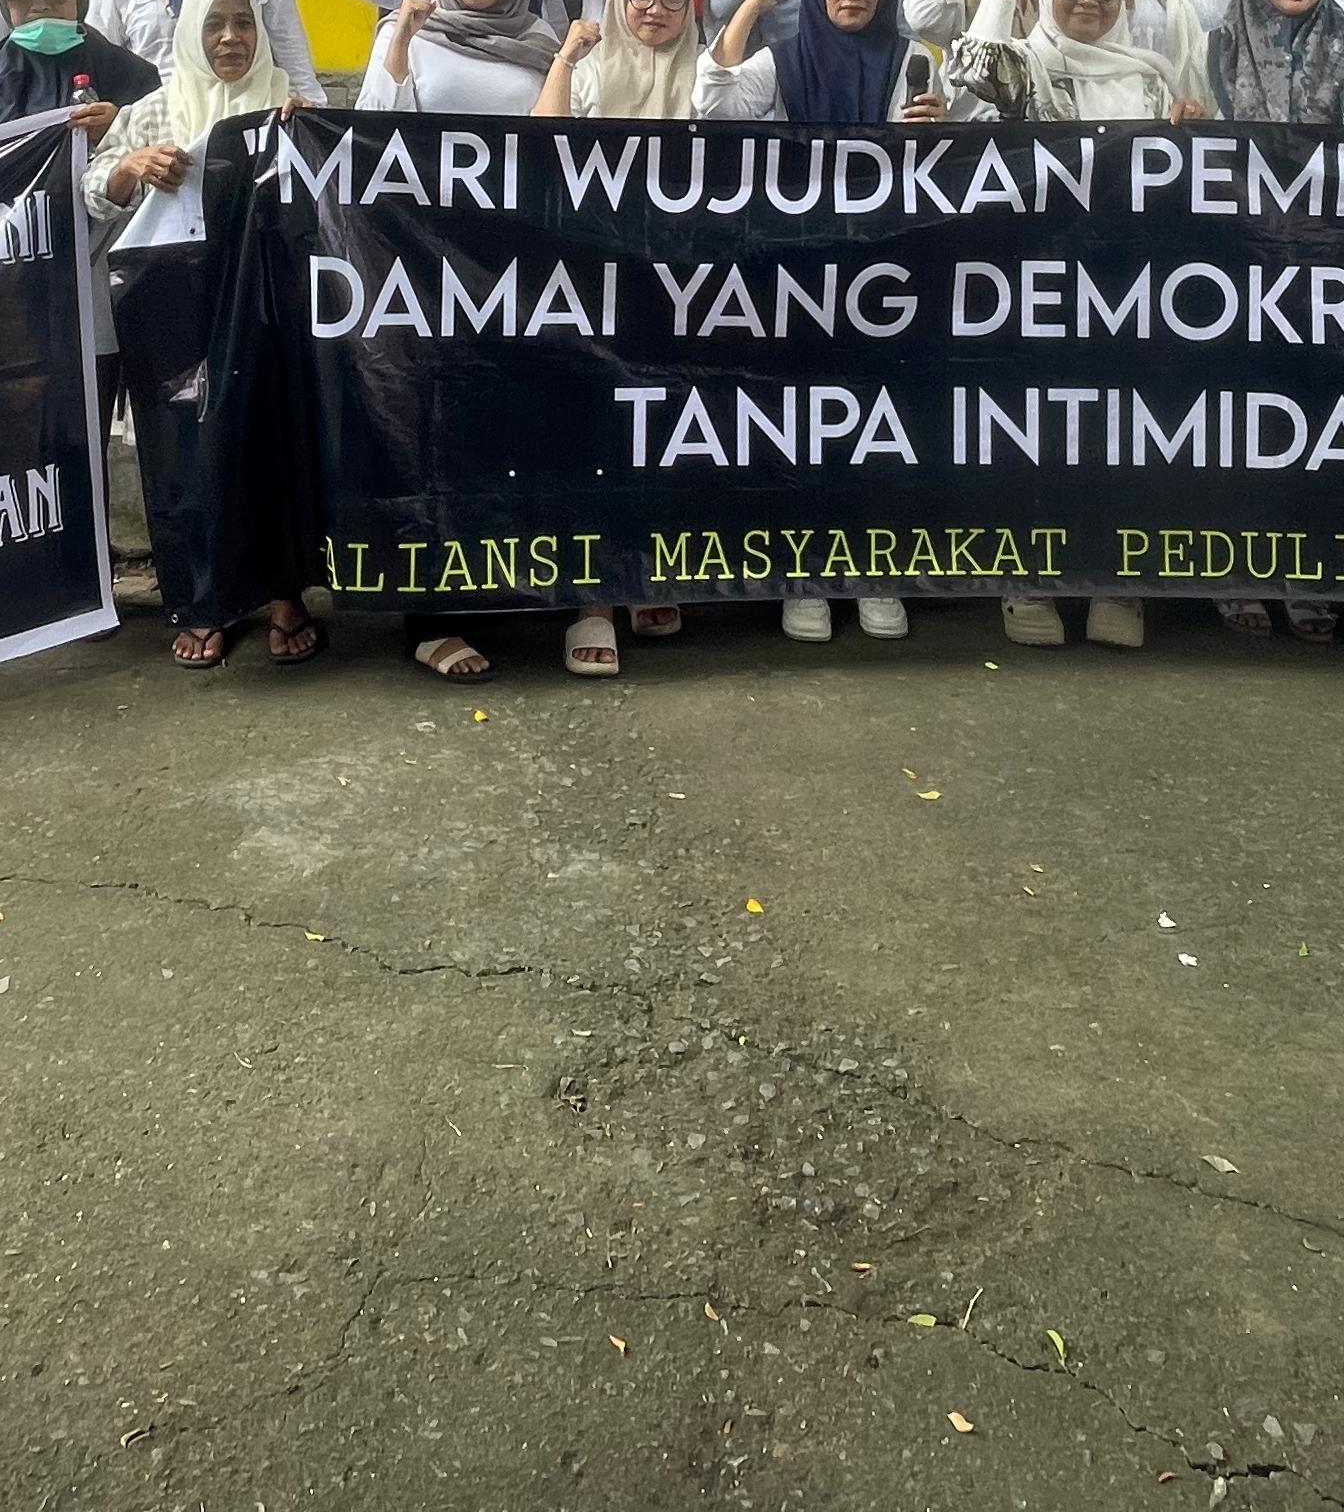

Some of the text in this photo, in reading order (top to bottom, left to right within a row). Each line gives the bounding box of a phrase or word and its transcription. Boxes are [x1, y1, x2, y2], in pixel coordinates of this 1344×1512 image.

[243, 126, 518, 210] "MARI
[555, 133, 1094, 215] WUJUDKAN
[309, 255, 617, 338] DAMAI
[652, 262, 918, 339] YANG
[614, 385, 919, 468] TANPA
[650, 528, 1067, 583] MASYARAKAT
